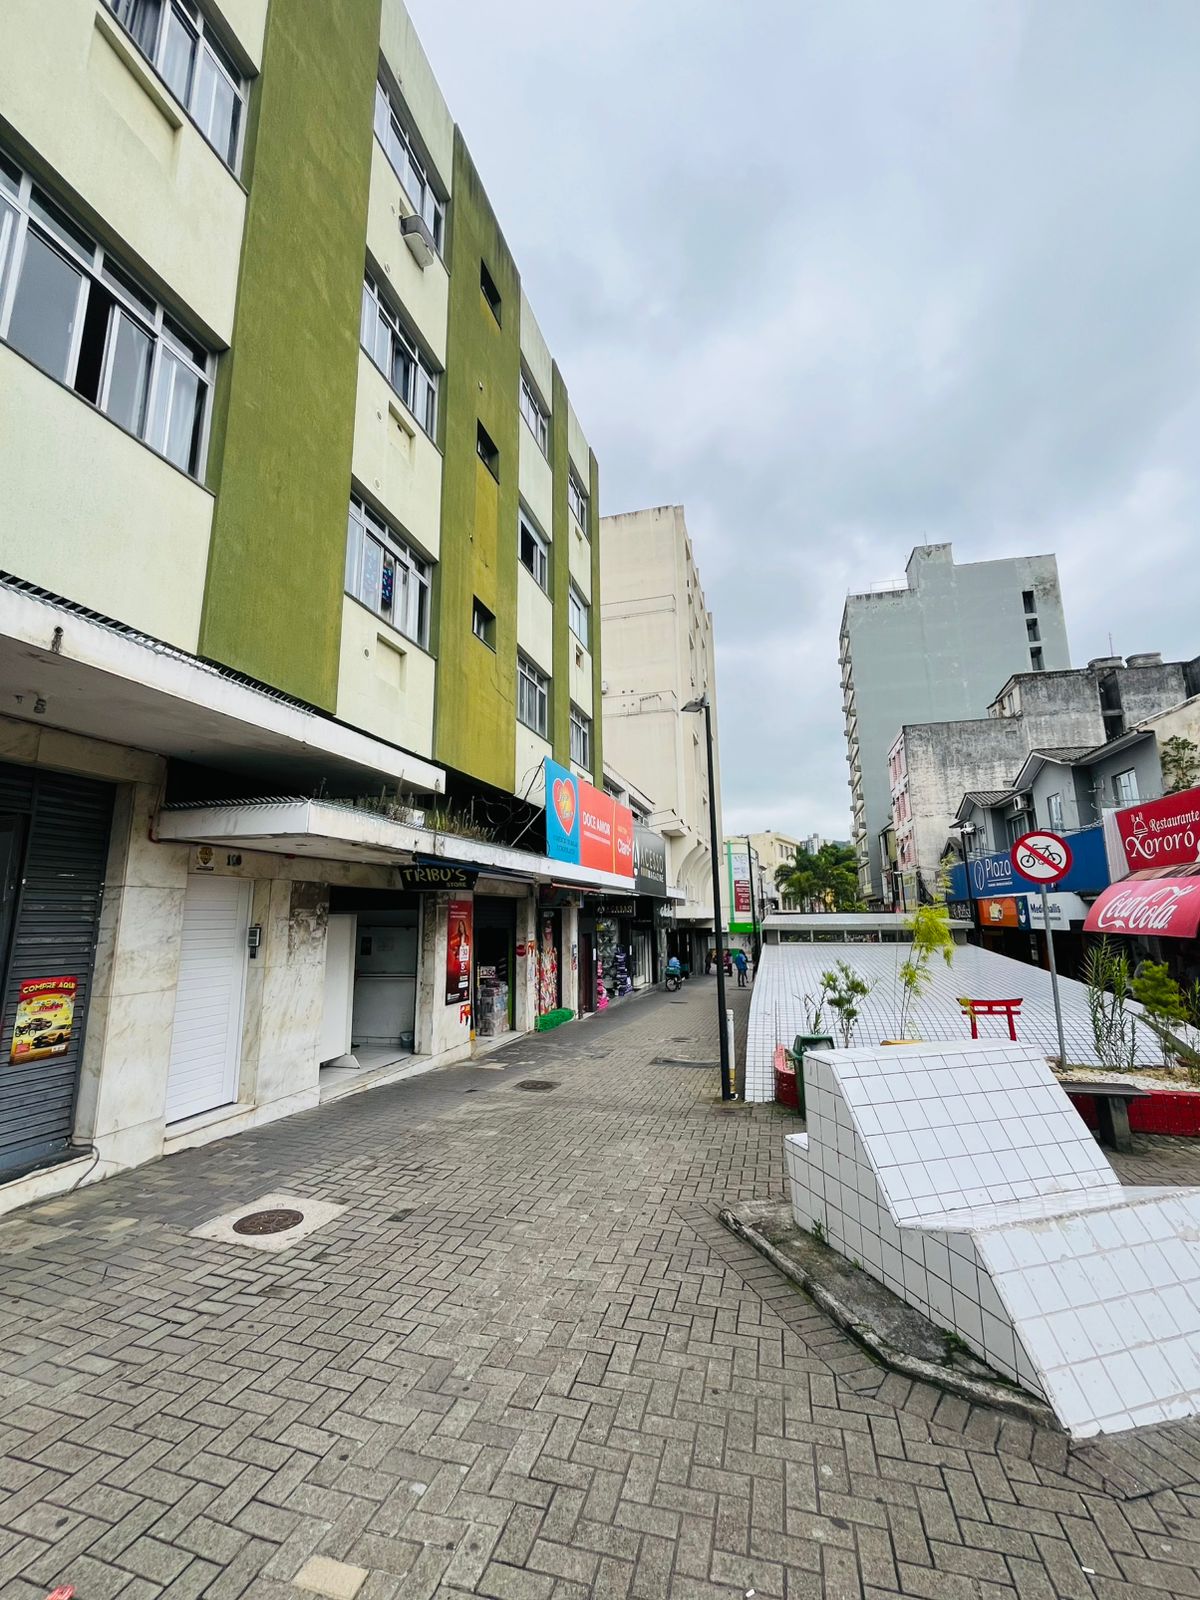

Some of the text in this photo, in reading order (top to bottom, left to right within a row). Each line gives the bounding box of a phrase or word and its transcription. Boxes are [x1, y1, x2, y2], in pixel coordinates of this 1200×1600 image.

[582, 811, 597, 830] DOCE
[596, 817, 611, 837] AMOR
[1149, 811, 1200, 833] Restaurante
[1125, 825, 1195, 860] Xororó
[640, 847, 664, 873] ACESSO
[985, 858, 1012, 878] Plaza
[402, 868, 467, 882] TRIBU'S
[22, 982, 57, 994] COMPRE
